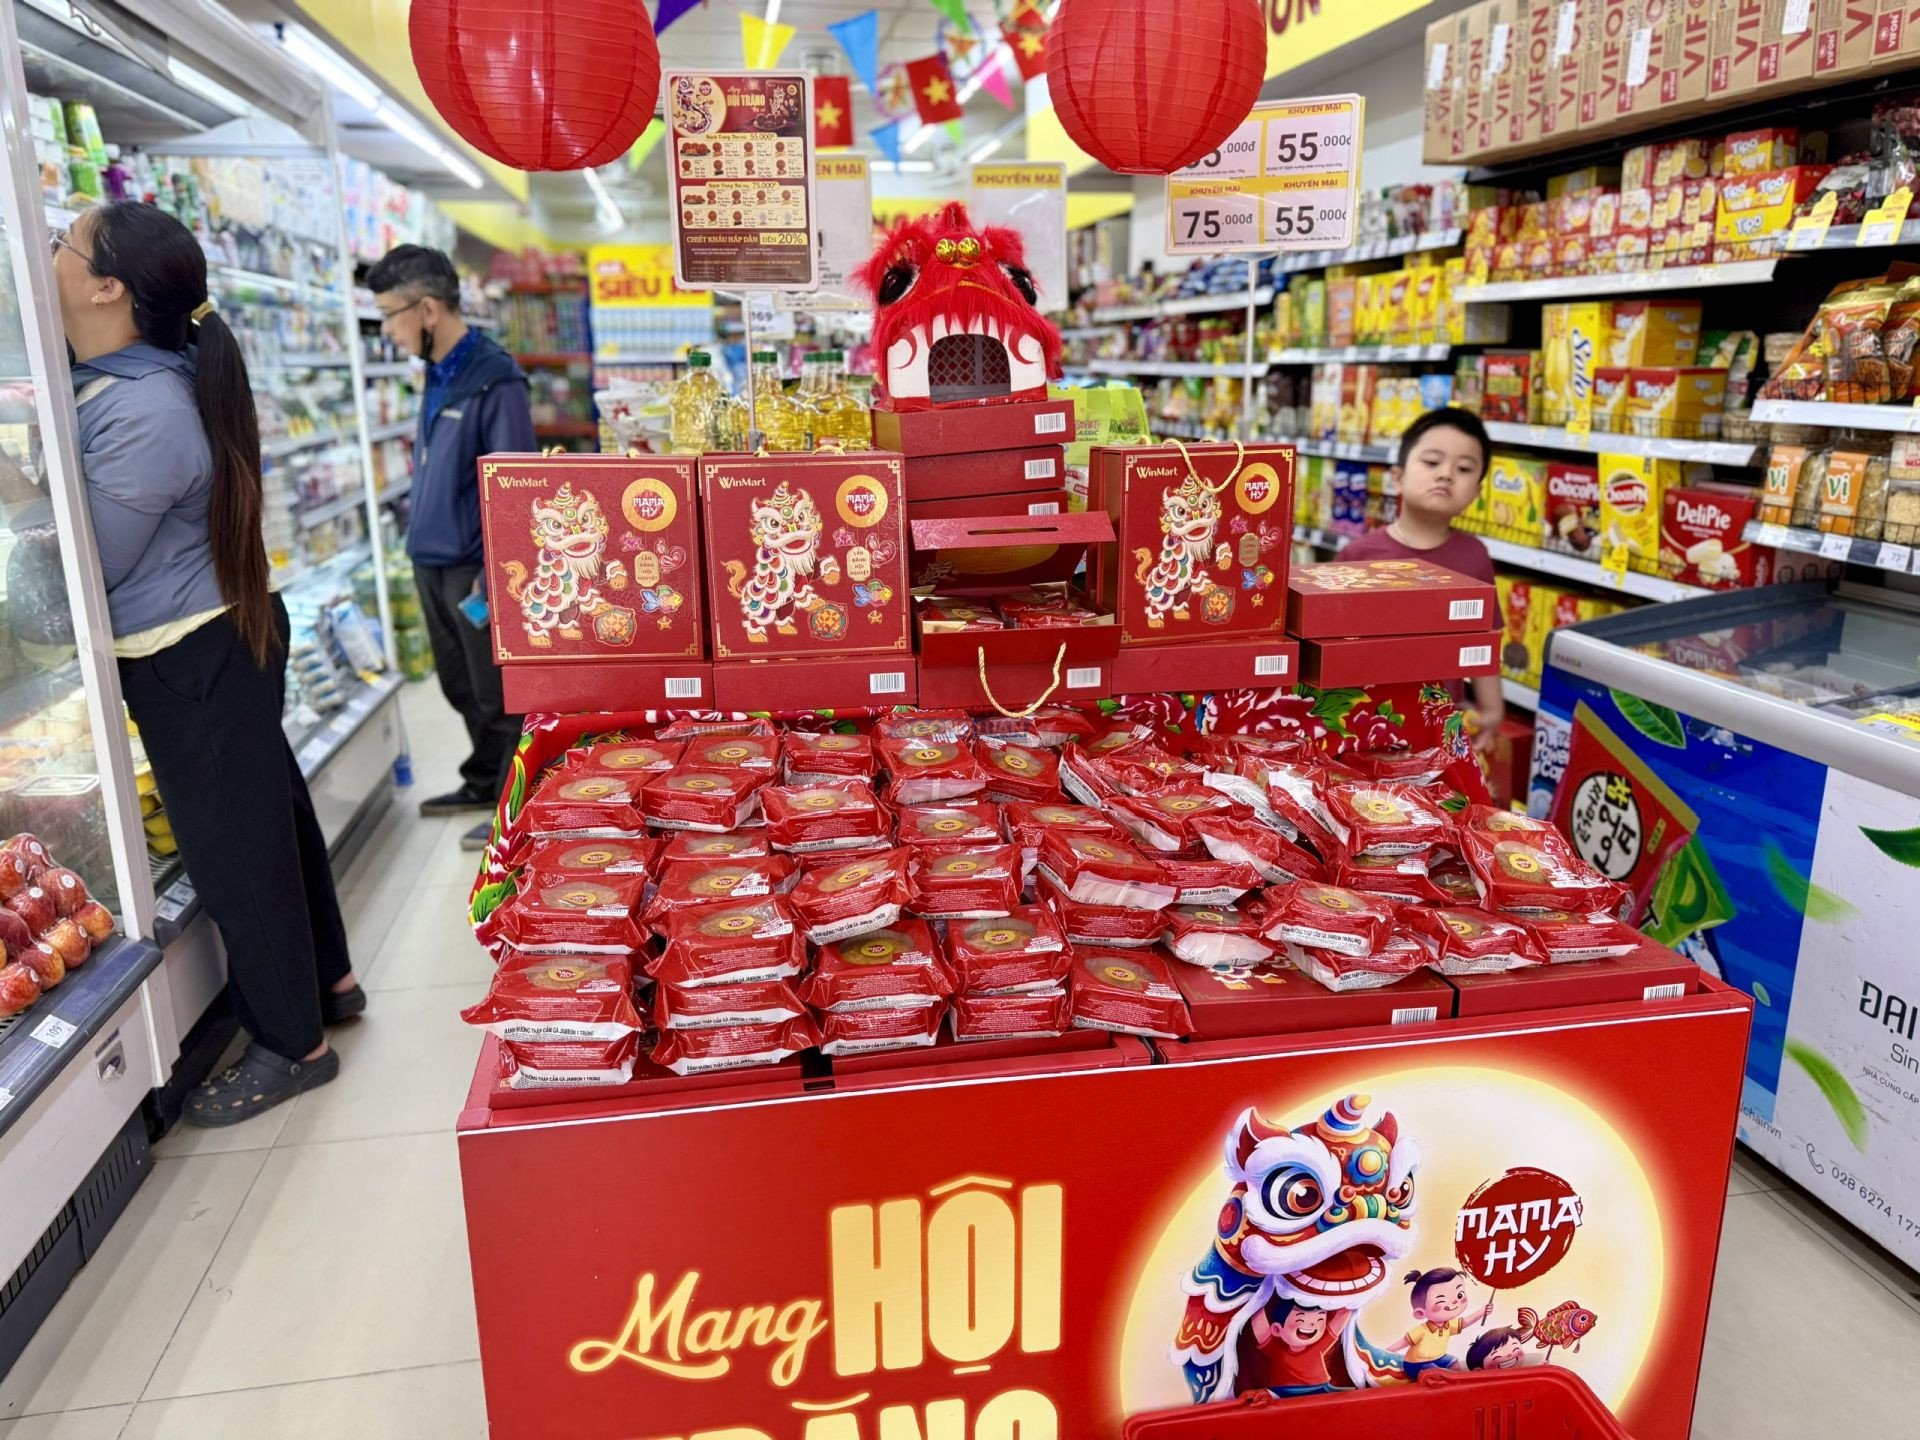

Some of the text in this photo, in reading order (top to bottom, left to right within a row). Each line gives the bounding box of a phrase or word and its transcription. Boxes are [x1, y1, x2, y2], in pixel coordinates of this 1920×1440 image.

[1888, 14, 1900, 49] VIFON
[1527, 7, 1549, 121] VIFON
[1467, 38, 1484, 130] VIFON
[1732, 138, 1759, 156] Tipo
[976, 171, 1031, 185] KHUYẾN
[1284, 179, 1338, 189] KHUYẾN MẠI
[687, 234, 706, 243] CHIẾT
[708, 233, 727, 243] KHẤU
[778, 233, 803, 244] 20%
[1137, 466, 1178, 479] WinMart
[497, 476, 549, 489] WinMart
[719, 477, 767, 490] WinMart
[1245, 482, 1270, 491] MAMA
[846, 494, 876, 504] MAMA
[1250, 490, 1263, 500] HY
[632, 498, 665, 508] MAMA
[854, 503, 870, 512] HY
[641, 507, 658, 518] HY
[1677, 501, 1731, 529] DeliPie
[1859, 981, 1918, 1041] ĐẠI
[543, 1025, 552, 1033] CẨM
[1862, 1066, 1878, 1081] NHÀ
[1879, 1077, 1901, 1095] CUNG
[1831, 1166, 1856, 1190] 028
[1859, 1186, 1891, 1218] 6274
[1456, 1195, 1583, 1242] MAMA
[1484, 1234, 1552, 1276] HY
[569, 1175, 1063, 1387] Mang HỘI
